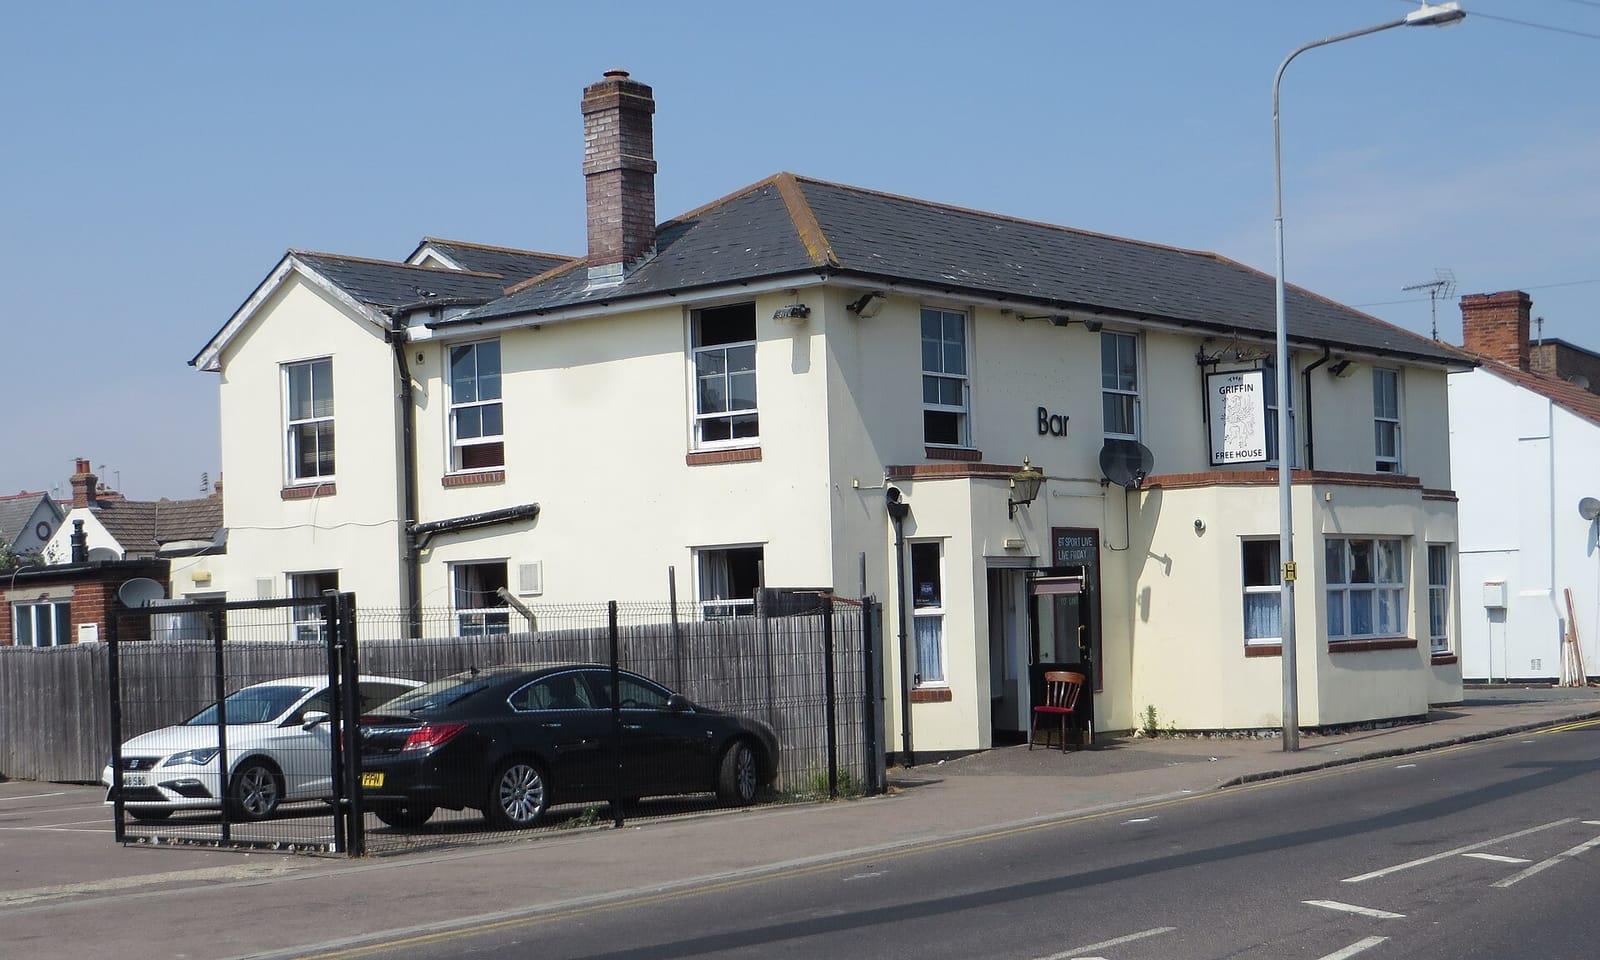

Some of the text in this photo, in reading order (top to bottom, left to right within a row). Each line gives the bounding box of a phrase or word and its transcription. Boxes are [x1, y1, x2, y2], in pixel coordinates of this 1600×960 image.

[1219, 384, 1254, 395] GRIFFIN
[1038, 406, 1070, 437] Bar
[1215, 449, 1263, 460] FREE HOUSE
[1081, 537, 1093, 547] LIVE
[1058, 550, 1069, 561] LIVE
[1285, 563, 1296, 579] H
